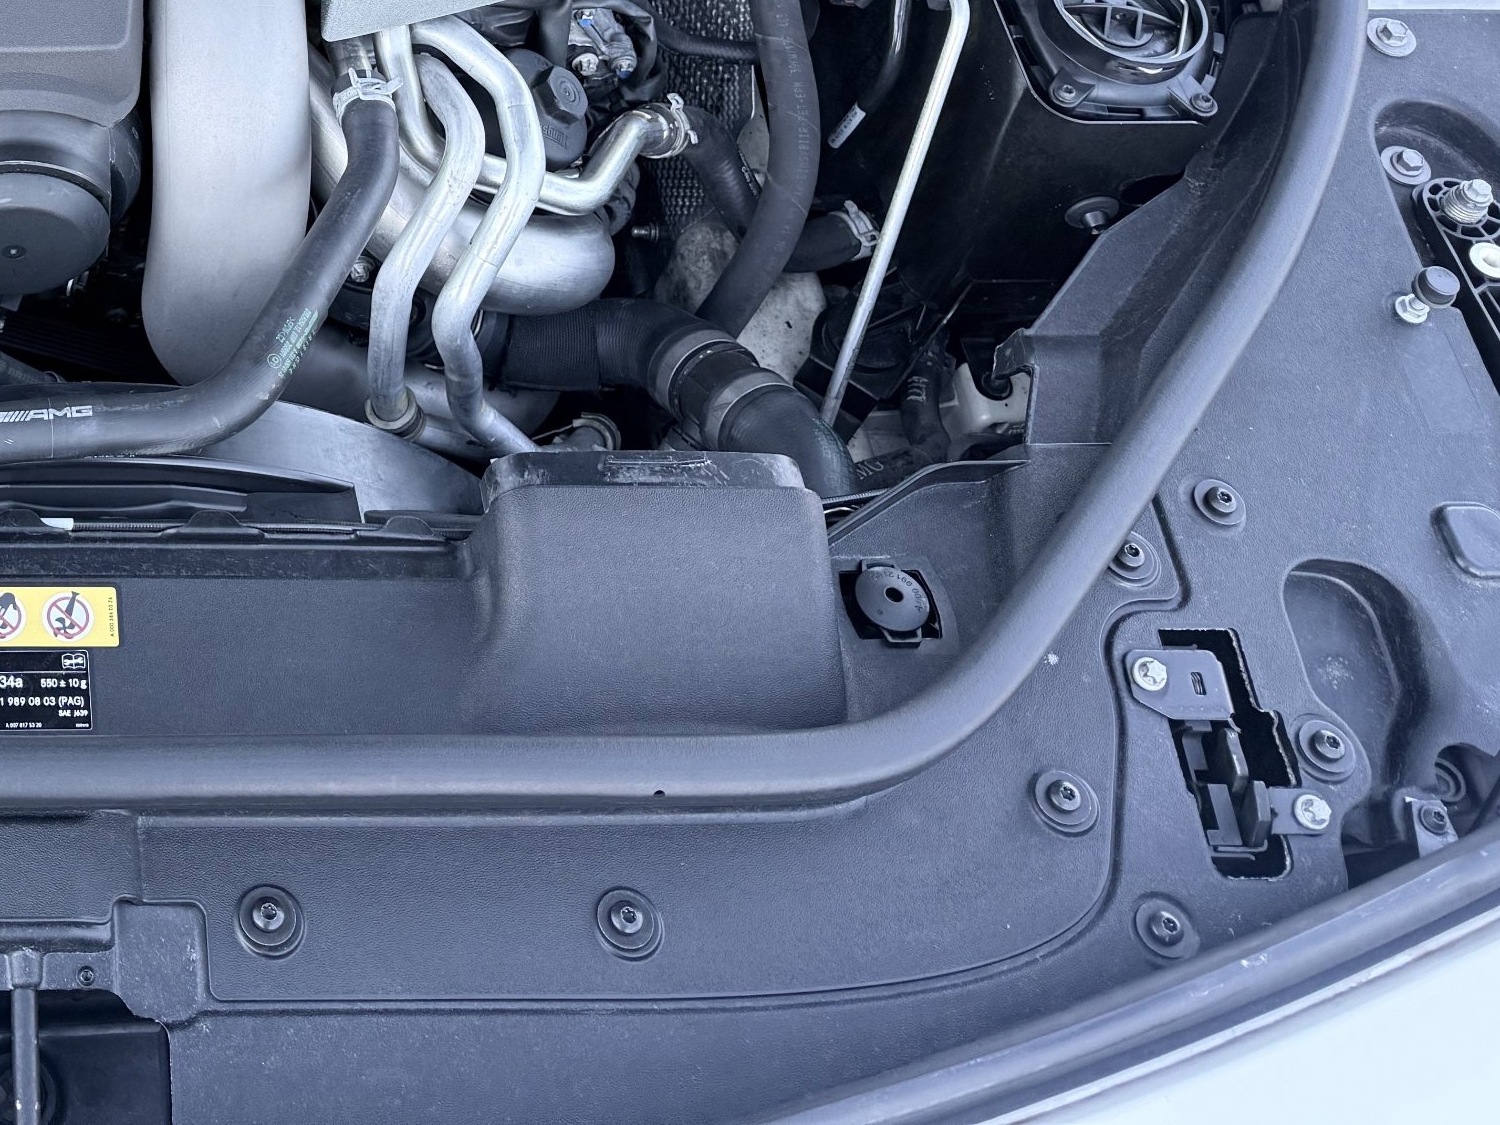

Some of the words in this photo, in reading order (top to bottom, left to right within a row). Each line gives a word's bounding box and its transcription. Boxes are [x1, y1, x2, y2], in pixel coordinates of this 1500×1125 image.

[25, 406, 92, 421] AMG
[40, 679, 58, 688] 550
[68, 679, 79, 688] 10
[80, 680, 87, 689] g
[8, 698, 25, 706] 989
[28, 698, 41, 706] 08
[43, 697, 56, 706] 03
[58, 696, 84, 707] (PAG)
